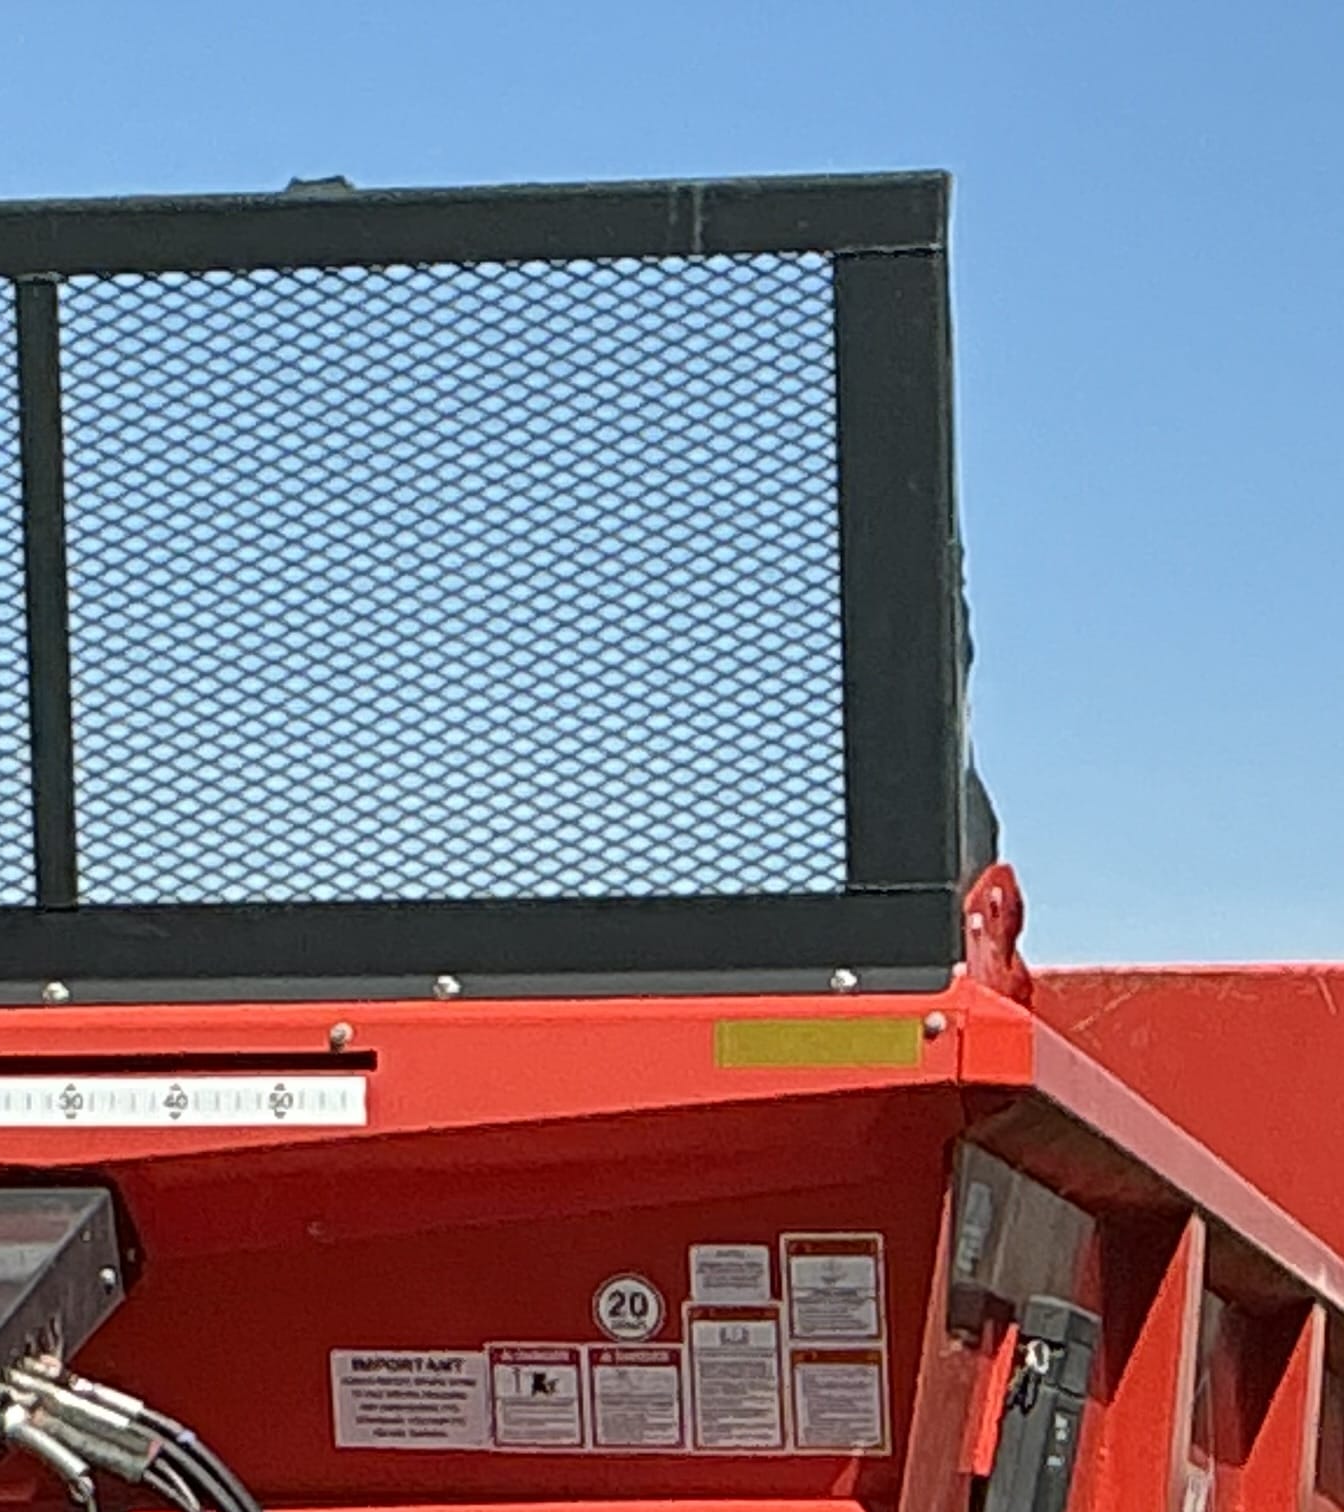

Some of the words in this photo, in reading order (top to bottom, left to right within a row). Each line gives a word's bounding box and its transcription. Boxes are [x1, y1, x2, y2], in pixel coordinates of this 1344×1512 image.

[59, 1092, 84, 1111] 30
[163, 1093, 189, 1110] 40
[608, 1290, 649, 1319] 20
